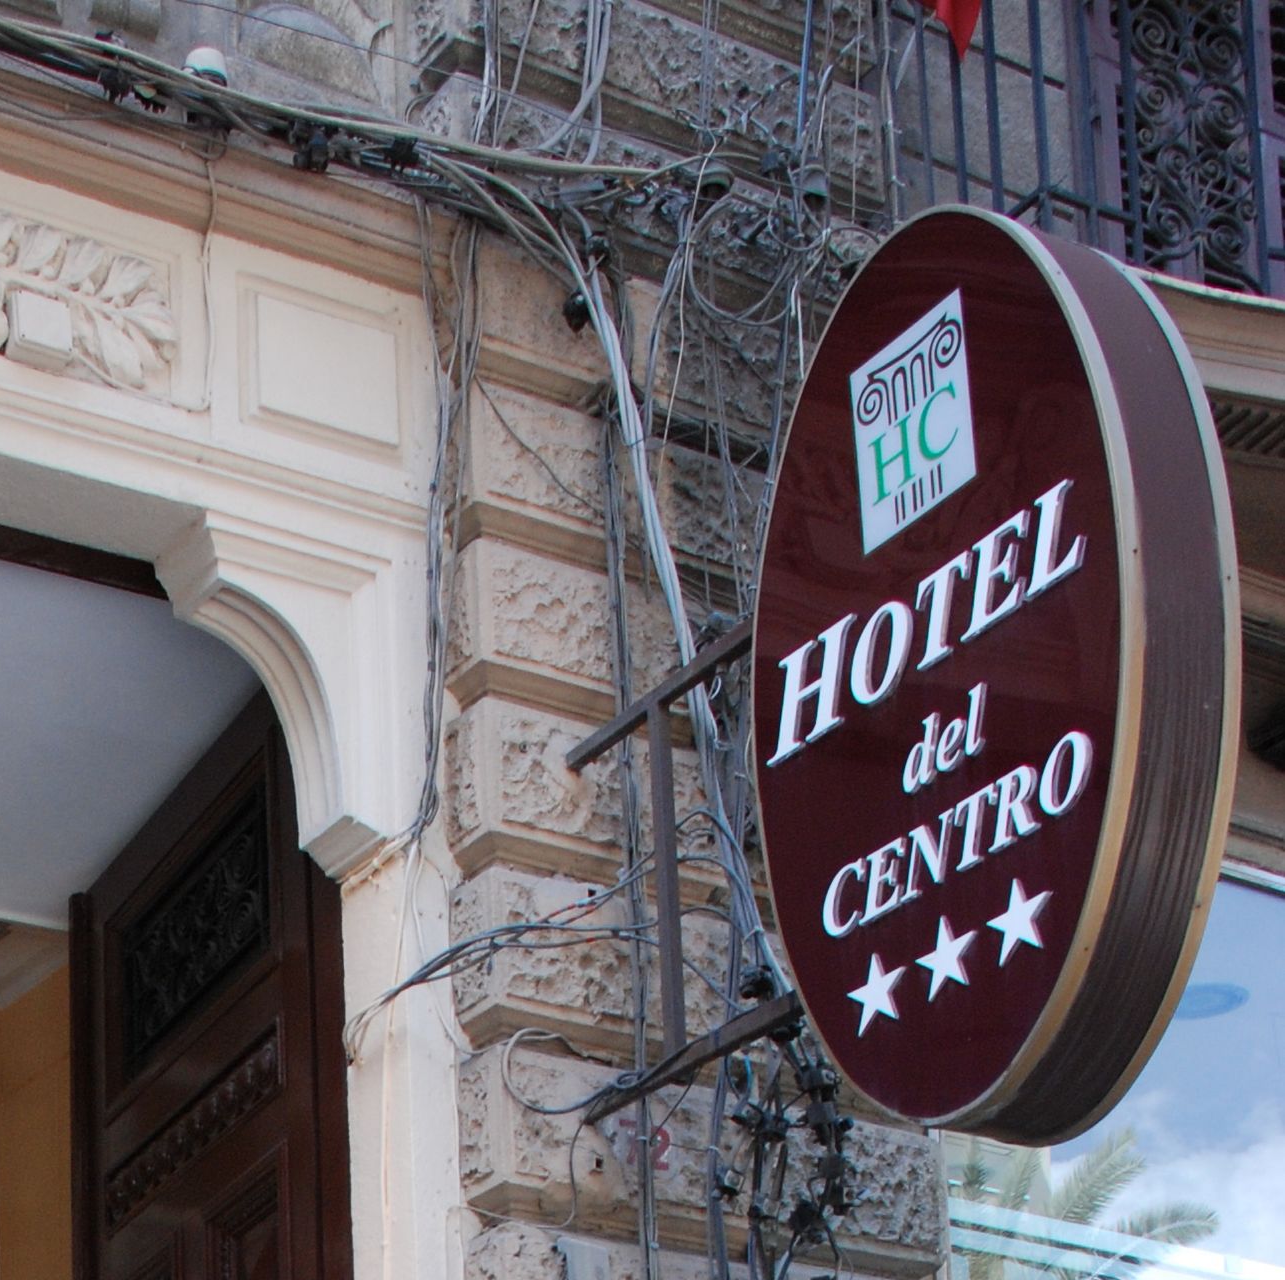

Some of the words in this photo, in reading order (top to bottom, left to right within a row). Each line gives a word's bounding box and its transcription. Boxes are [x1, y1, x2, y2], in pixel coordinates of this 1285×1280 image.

[867, 380, 960, 508] HC
[766, 478, 1088, 768] HOTEL
[902, 682, 988, 793] del
[822, 731, 1093, 938] CENTRO
